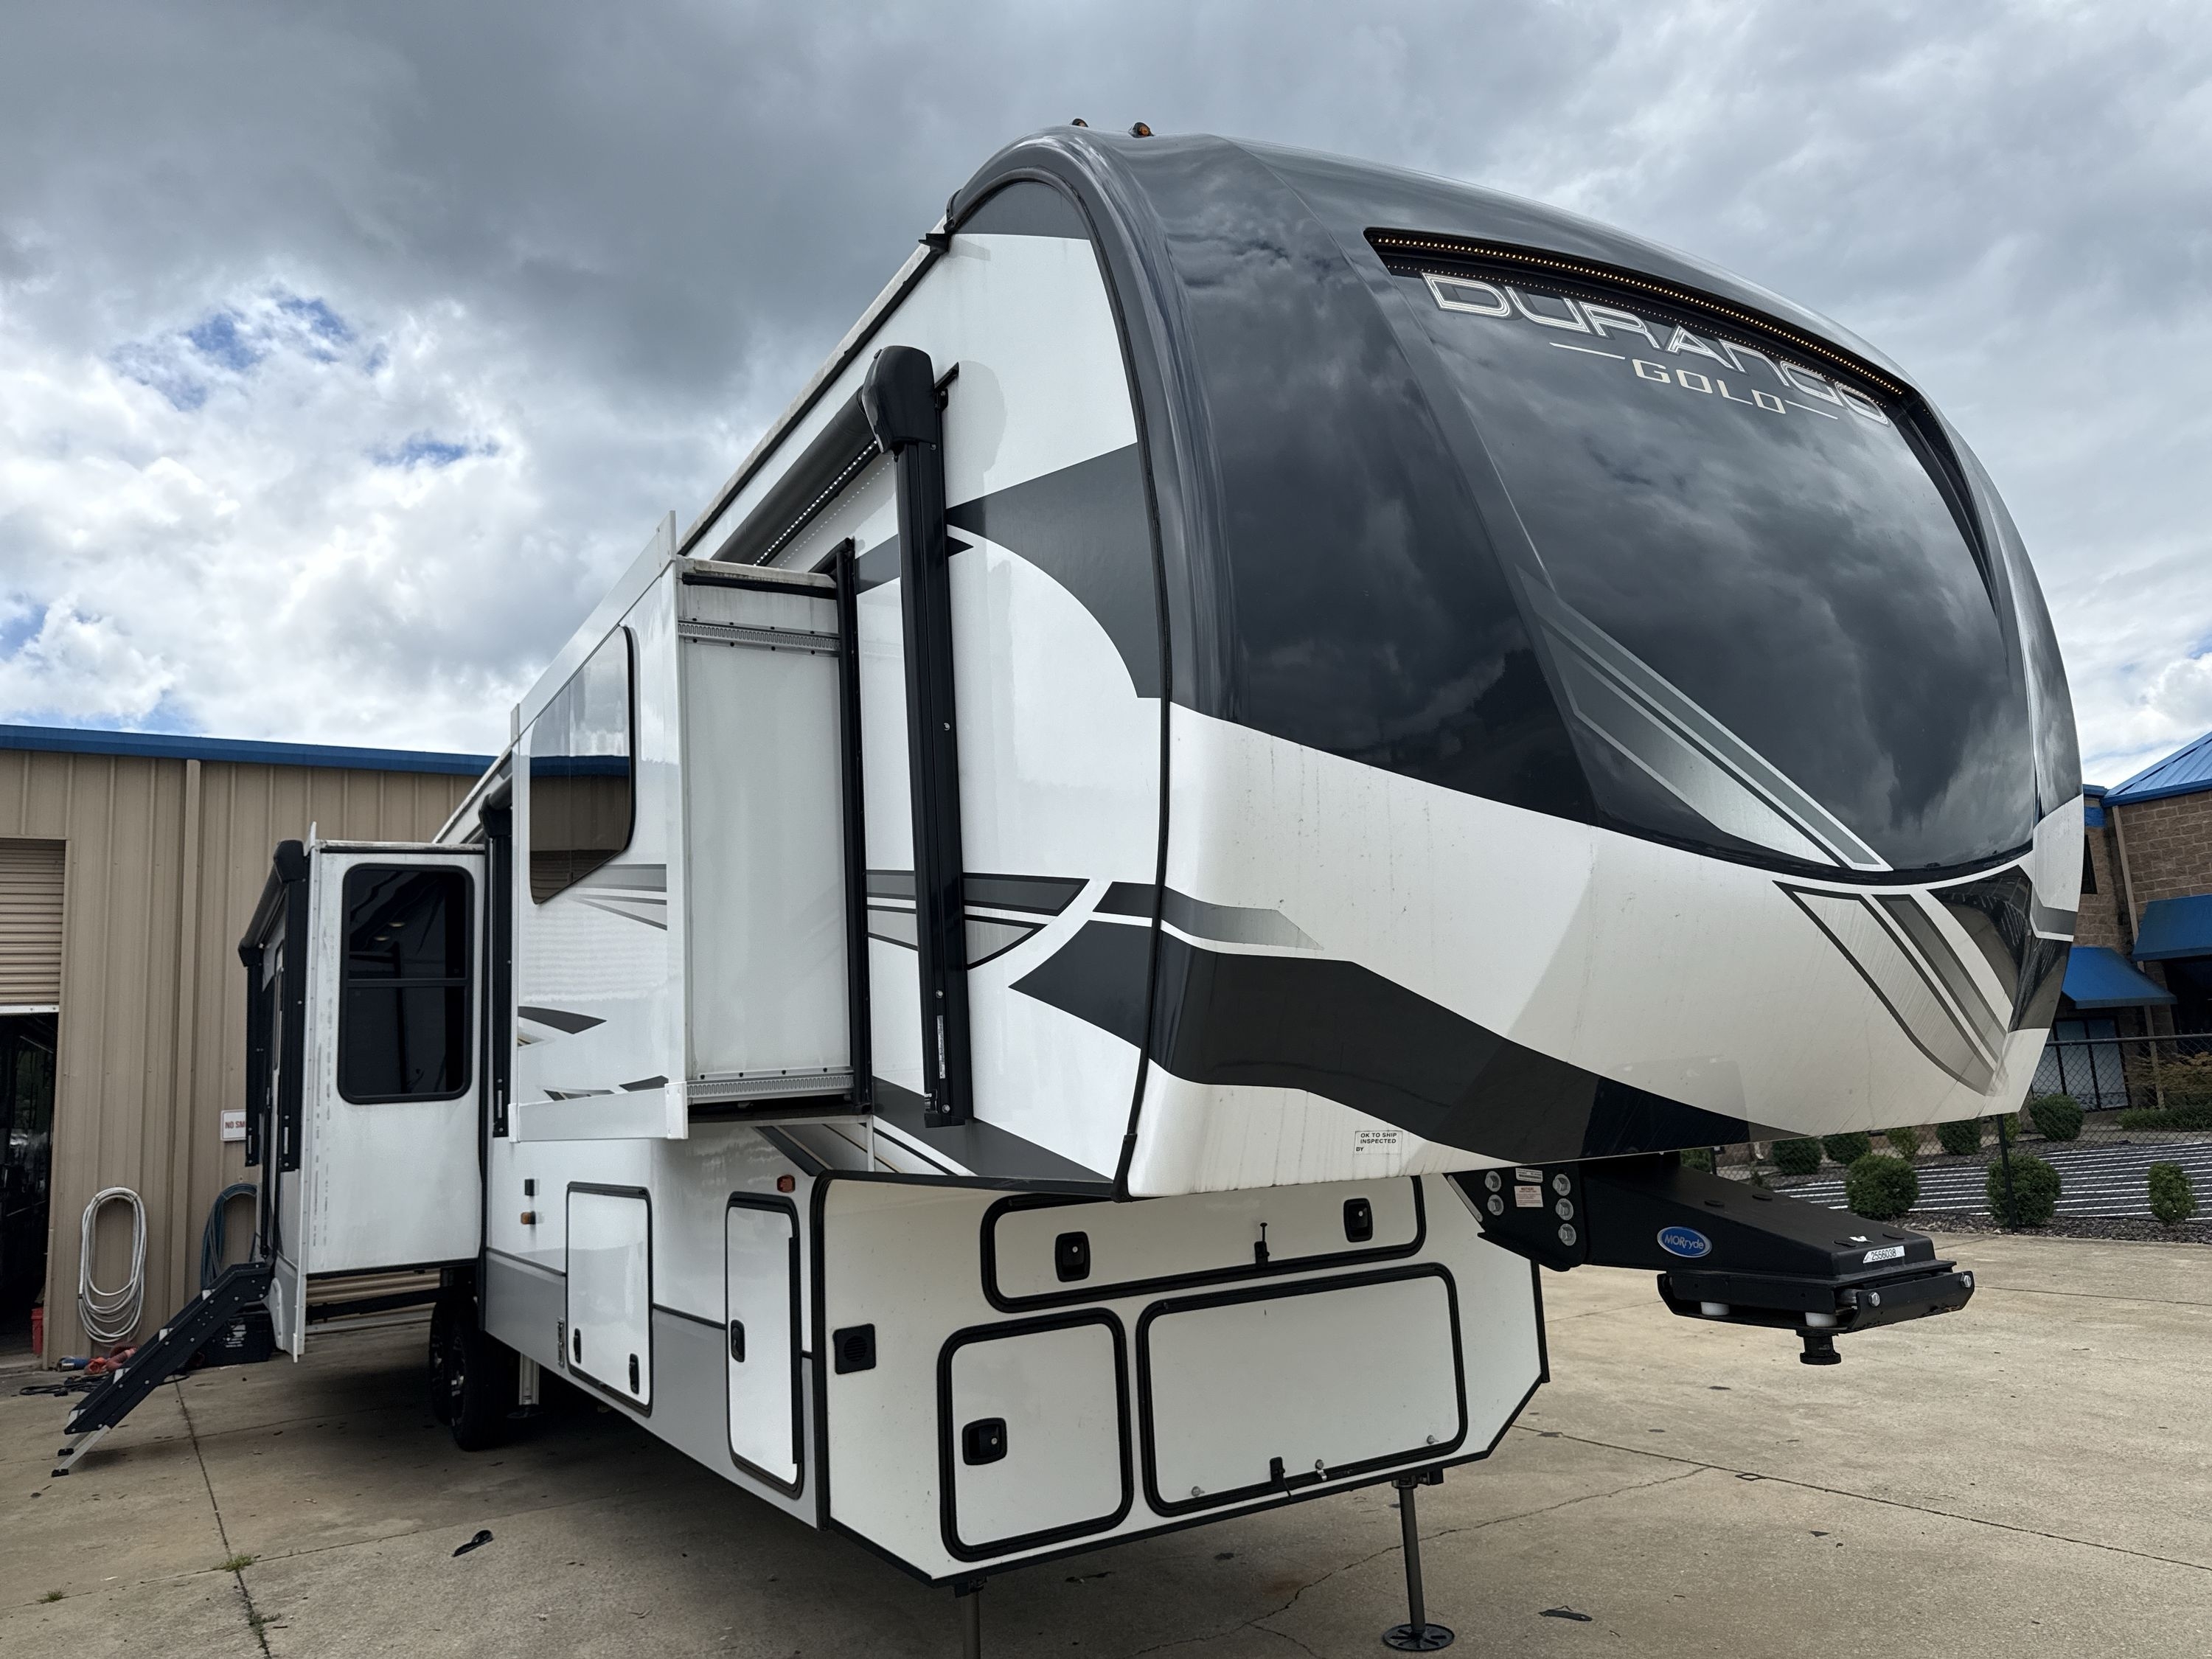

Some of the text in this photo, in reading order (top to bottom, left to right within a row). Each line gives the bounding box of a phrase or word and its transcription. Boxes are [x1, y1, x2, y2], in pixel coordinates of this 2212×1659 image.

[1422, 271, 1891, 428] DURANGO
[1631, 358, 1787, 415] GOLD
[1664, 1234, 1704, 1250] MORryde
[1871, 1248, 1896, 1261] 2556038
